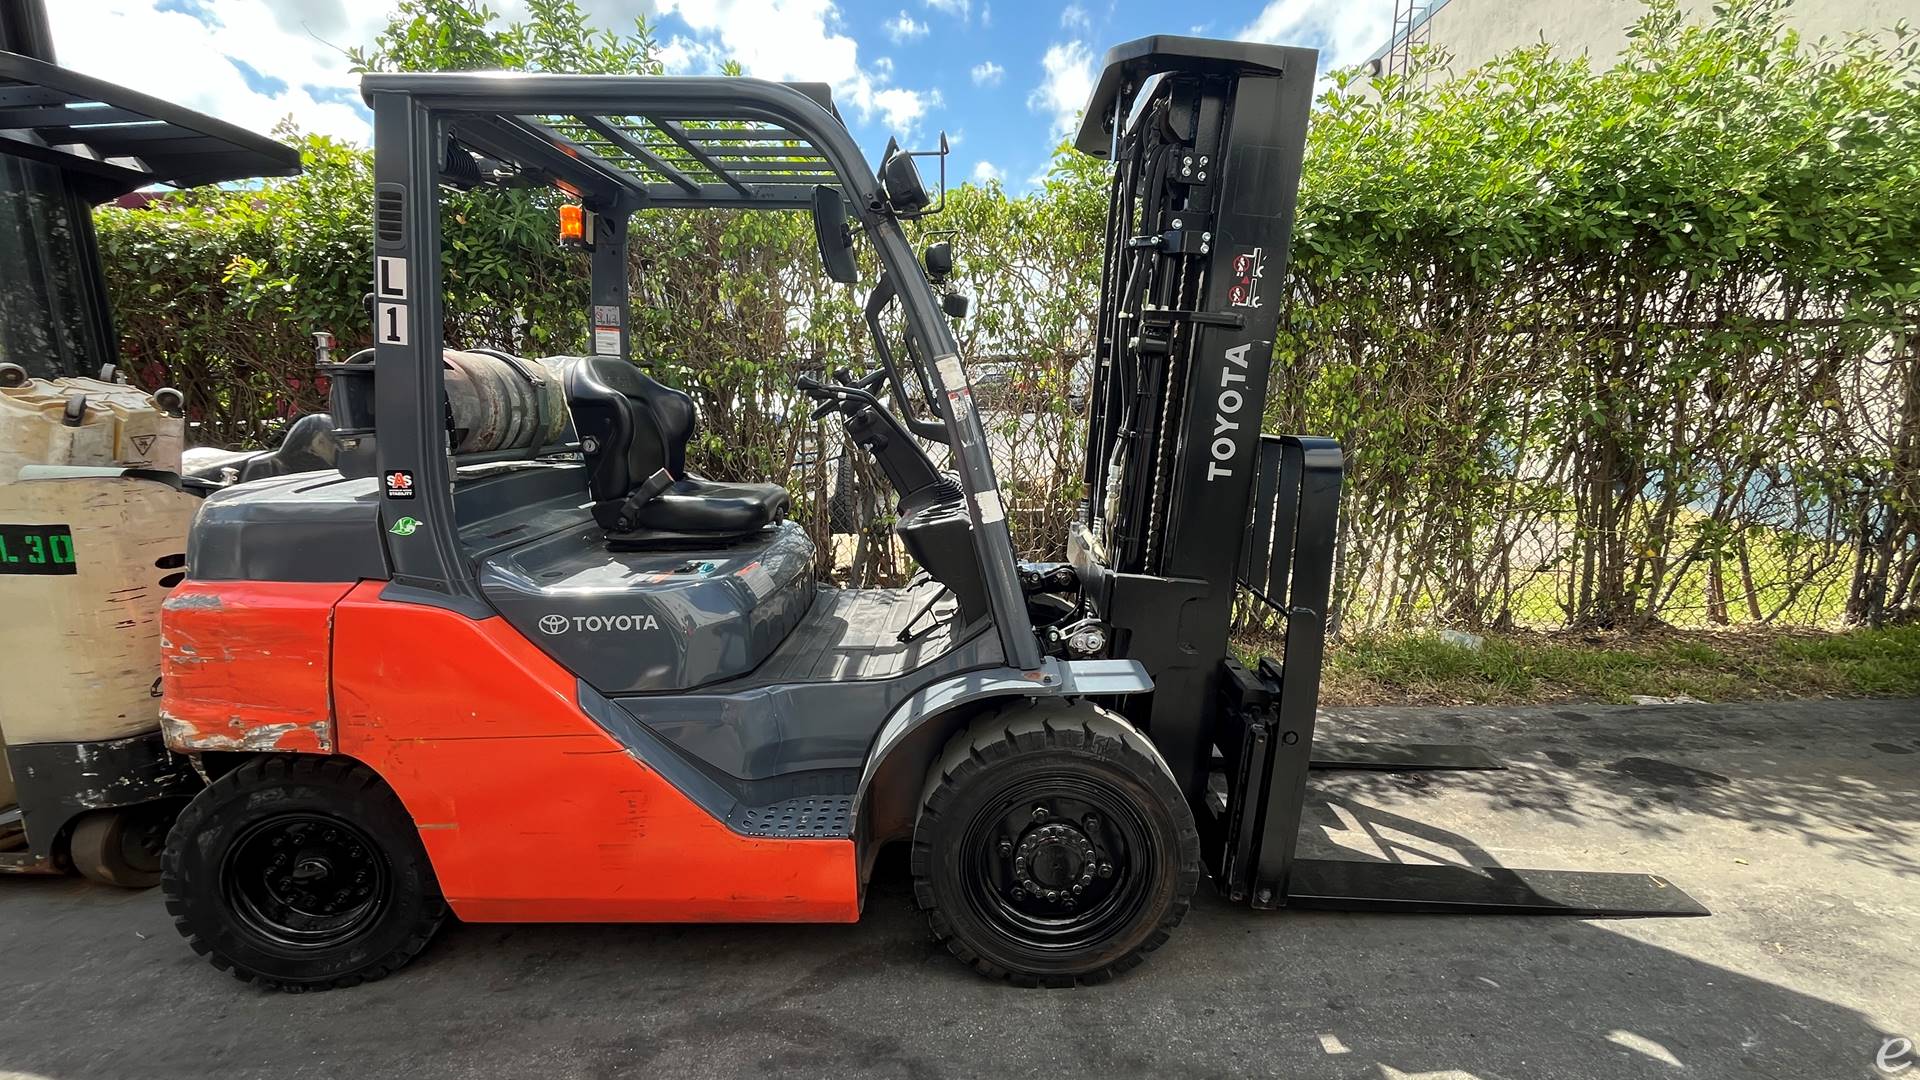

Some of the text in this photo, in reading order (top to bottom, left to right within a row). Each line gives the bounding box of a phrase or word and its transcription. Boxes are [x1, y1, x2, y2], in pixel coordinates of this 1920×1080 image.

[381, 259, 403, 295] L
[386, 307, 401, 342] 1
[1207, 342, 1251, 481] TOYOTA
[386, 472, 412, 488] SAS
[572, 614, 660, 632] TOYOTA
